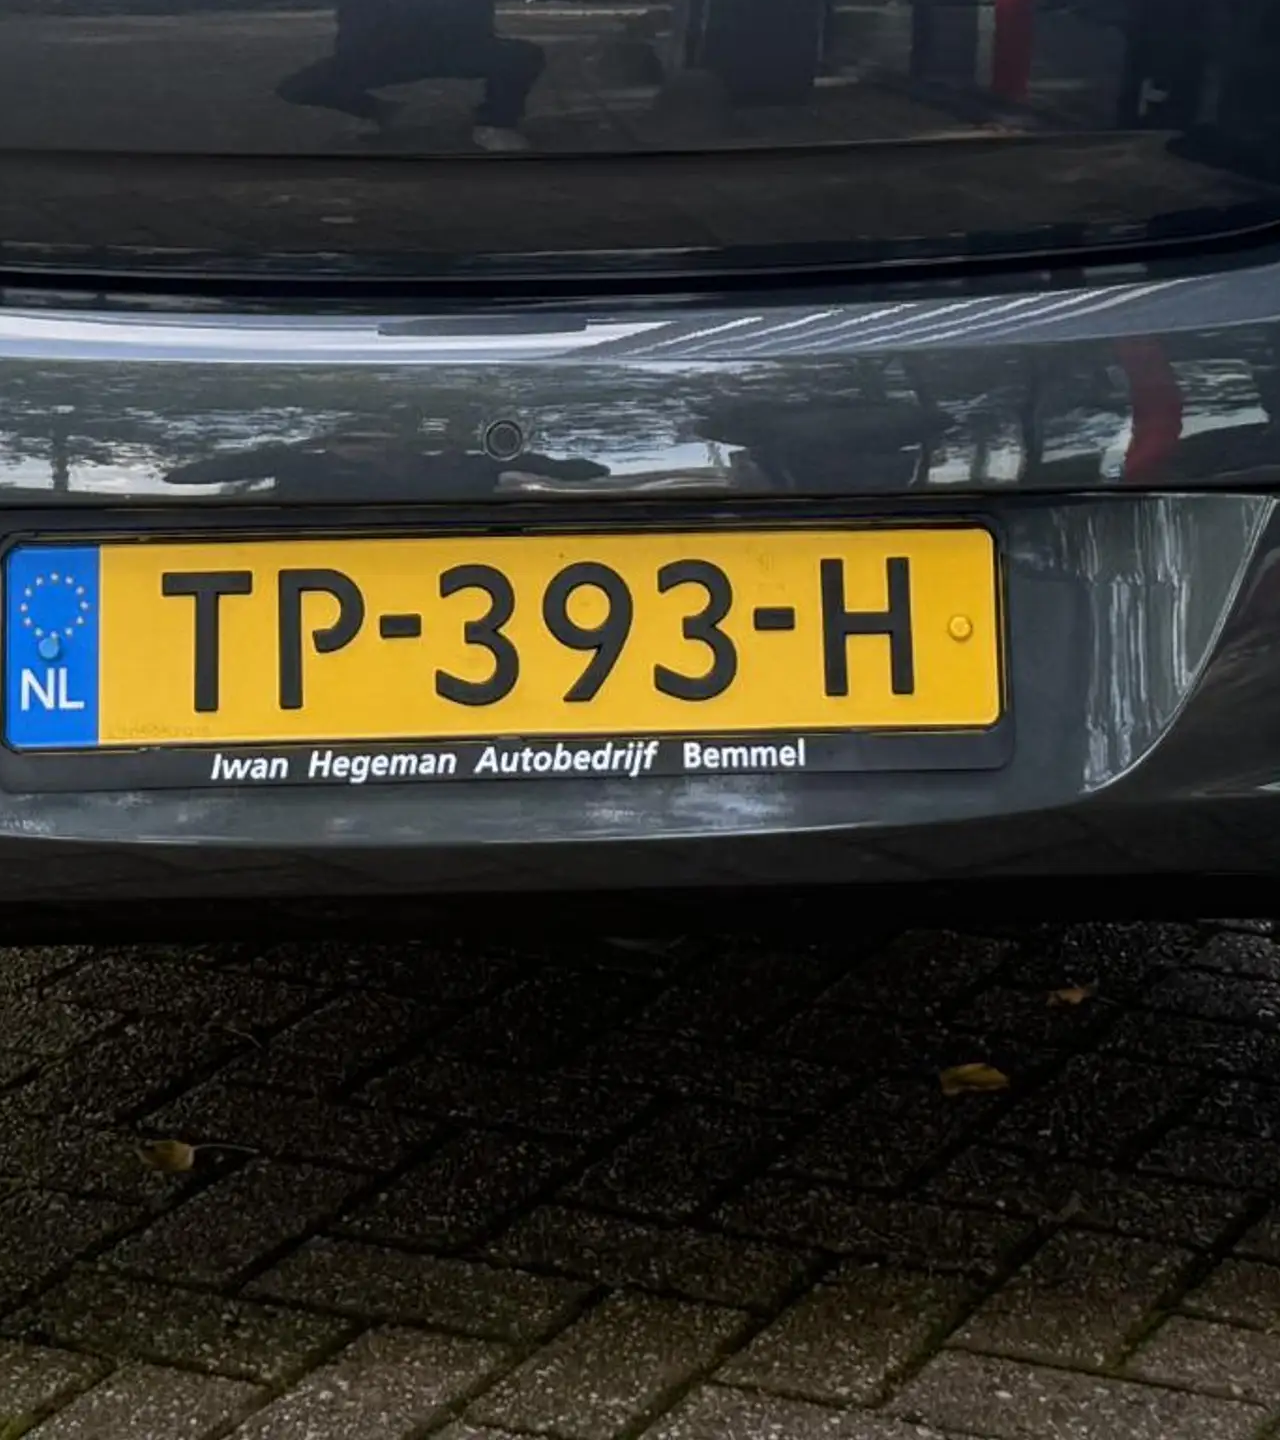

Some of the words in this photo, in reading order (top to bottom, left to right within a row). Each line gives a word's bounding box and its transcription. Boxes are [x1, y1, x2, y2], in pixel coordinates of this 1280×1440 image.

[21, 667, 85, 711] NL
[161, 557, 915, 713] TP-393-H
[210, 752, 289, 780] Iwan
[307, 748, 457, 784] Hegeman
[473, 740, 660, 778] Autobedrijf
[683, 737, 806, 769] Bemmel
